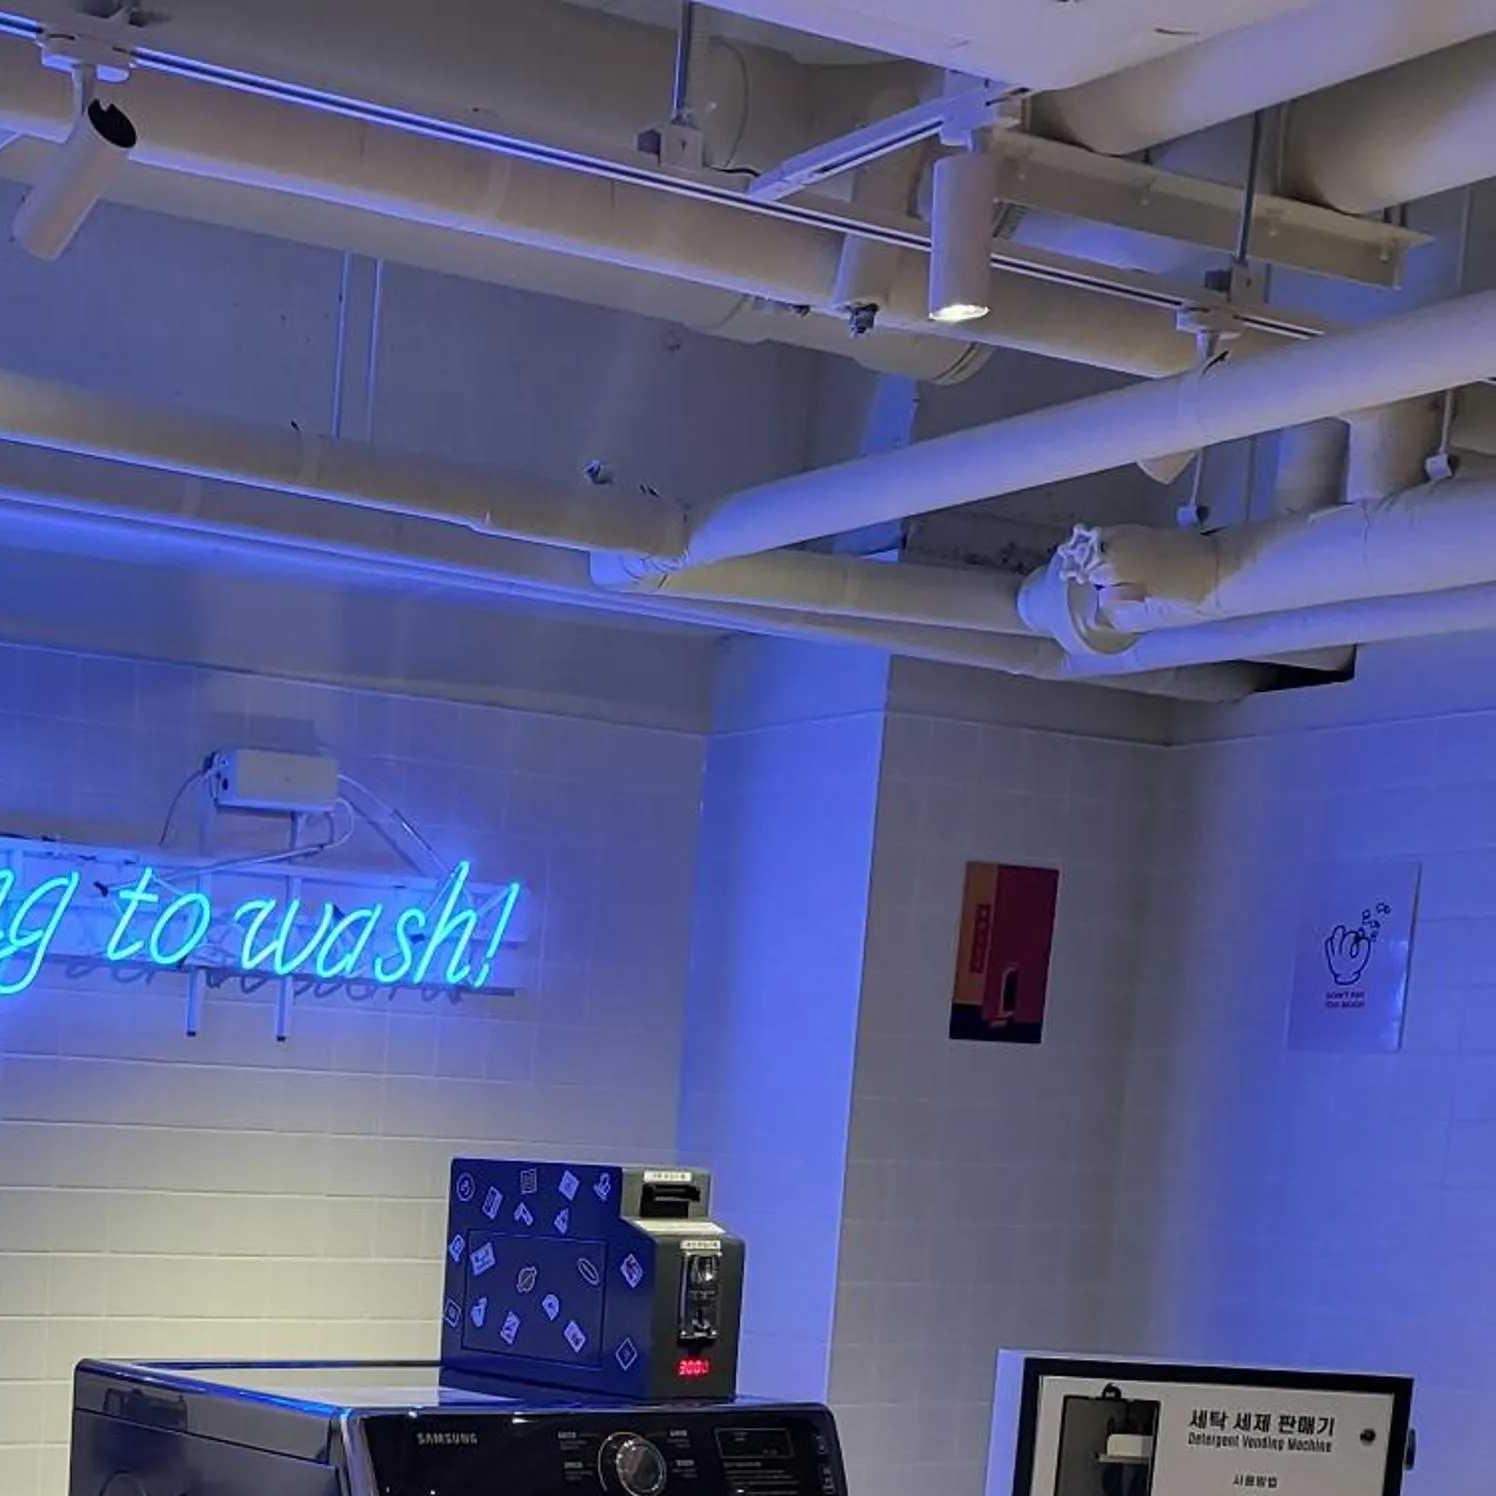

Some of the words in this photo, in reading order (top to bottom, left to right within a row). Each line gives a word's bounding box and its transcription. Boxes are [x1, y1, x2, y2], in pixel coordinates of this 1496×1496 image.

[107, 864, 212, 966] to
[233, 859, 522, 989] wash!
[1188, 1409, 1229, 1431] 세탁
[1232, 1412, 1272, 1433] 세제
[1278, 1414, 1336, 1437] 판매기
[416, 1431, 478, 1446] SAMSUNG
[1187, 1431, 1240, 1449] Detergent
[1242, 1434, 1285, 1451] Vending
[1287, 1437, 1333, 1453] Machine
